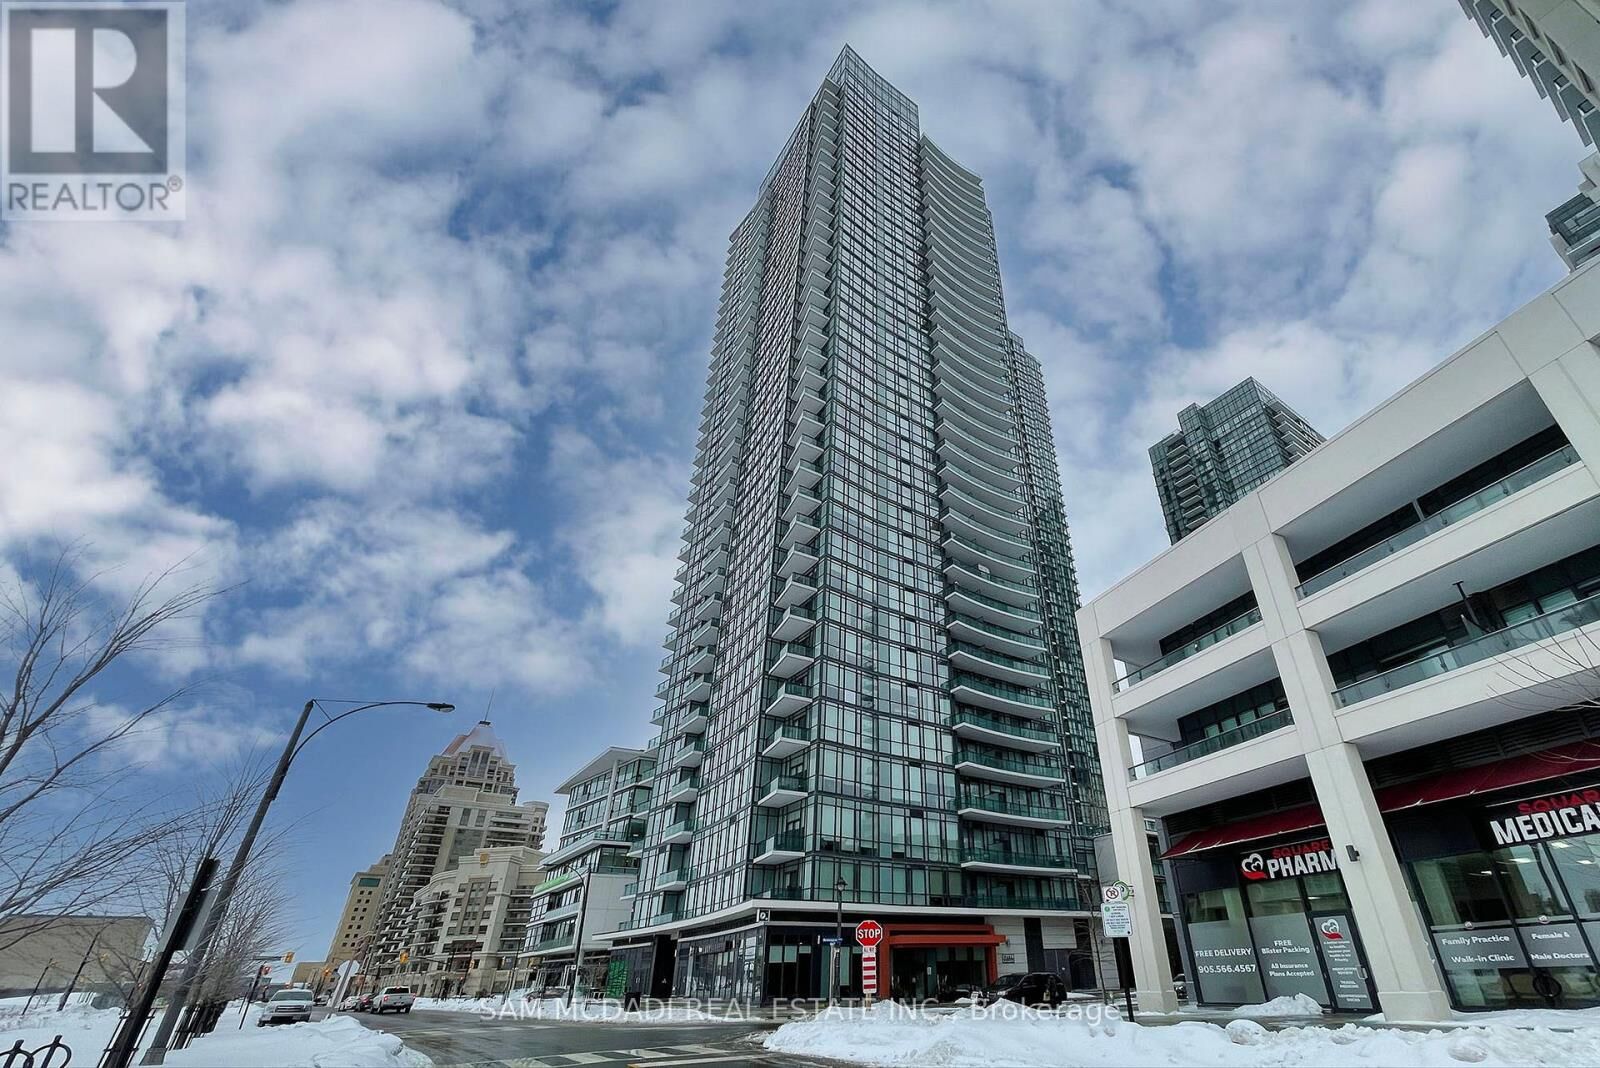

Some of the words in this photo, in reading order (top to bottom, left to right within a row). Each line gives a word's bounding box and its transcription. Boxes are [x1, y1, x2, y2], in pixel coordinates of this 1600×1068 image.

[1489, 802, 1600, 845] MEDICA
[1272, 840, 1331, 859] SQUARE
[858, 928, 881, 939] STOP
[1531, 932, 1563, 940] Female
[1441, 937, 1471, 946] Family
[1472, 934, 1510, 944] Practice
[1194, 949, 1214, 957] FREE
[1214, 947, 1252, 957] DELIVERY
[1283, 945, 1310, 954] Packing
[1451, 955, 1487, 963] Walk-in
[1488, 953, 1516, 962] Clinic
[1531, 952, 1552, 960] Male
[1552, 952, 1590, 960] Doctors
[1197, 964, 1257, 974] 905.566.4567
[1286, 970, 1315, 978] Accepted
